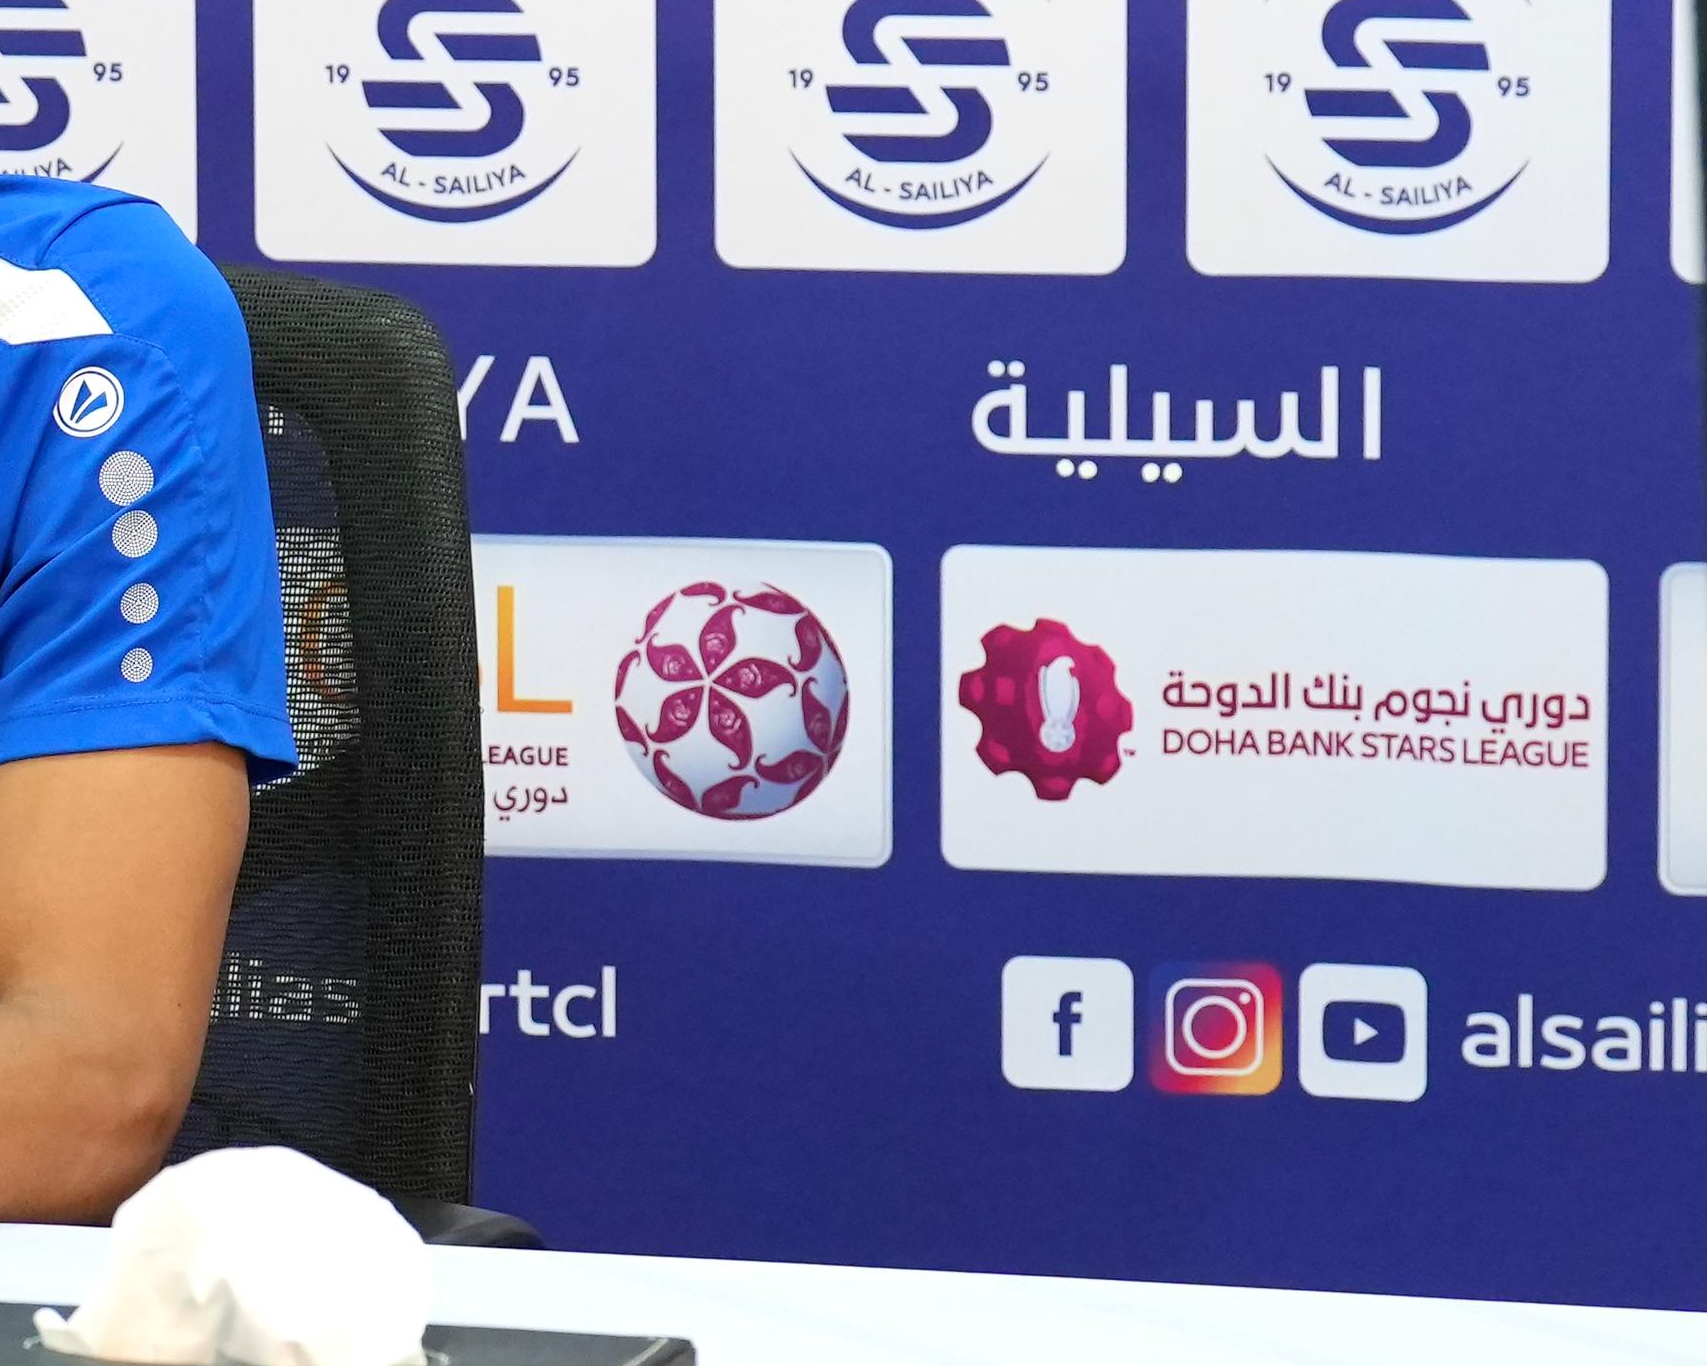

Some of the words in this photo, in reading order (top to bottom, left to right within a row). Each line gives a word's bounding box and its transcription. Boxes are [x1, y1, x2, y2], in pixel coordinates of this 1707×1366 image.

[972, 361, 1380, 482] السيلية
[1161, 670, 1292, 719] الدوحة
[1301, 673, 1364, 723] بنك
[1373, 680, 1471, 728] نجوم
[1480, 693, 1591, 736] دوري
[479, 744, 571, 768] EAGUE
[1162, 728, 1261, 757] DOHA
[1266, 729, 1355, 759] BANK
[1360, 732, 1457, 765] STARS
[1462, 738, 1590, 769] LEAGUE
[491, 785, 571, 823] دوري
